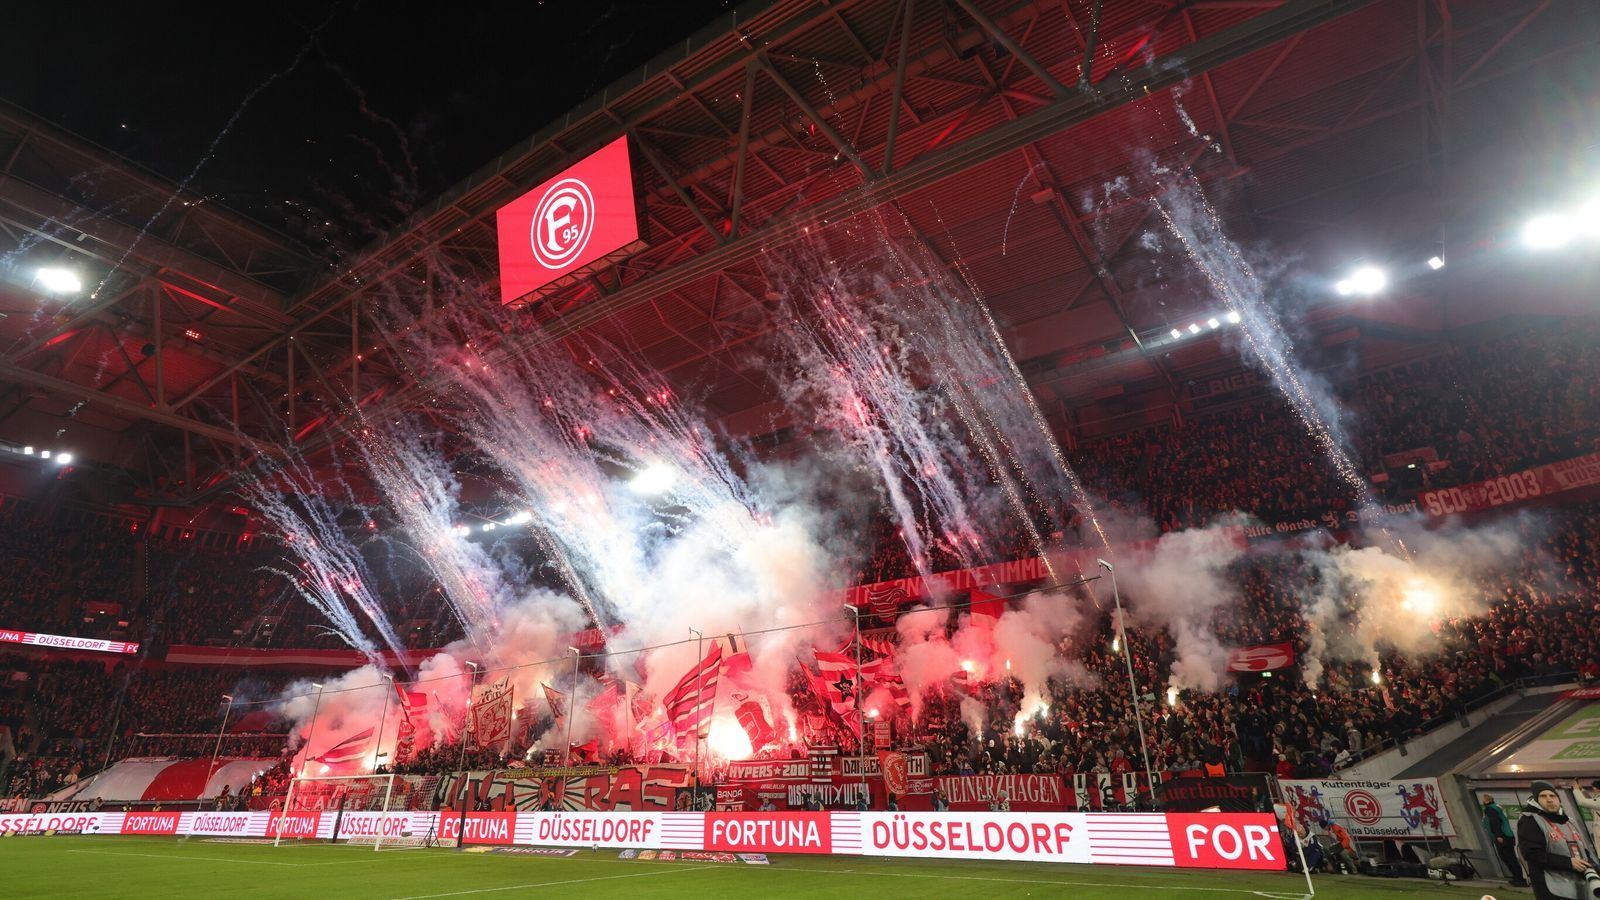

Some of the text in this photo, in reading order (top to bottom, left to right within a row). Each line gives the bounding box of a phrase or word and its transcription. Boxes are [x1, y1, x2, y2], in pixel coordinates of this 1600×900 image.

[562, 224, 579, 243] 95
[1425, 469, 1542, 517] SCD 2003
[38, 635, 106, 649] DÜSSELDORF
[728, 764, 773, 779] HYPERS
[782, 763, 810, 777] 2001
[717, 789, 743, 799] BANDA
[940, 774, 1060, 803] MEINERZHAGEN
[1321, 781, 1391, 789] Kuttenträger
[125, 816, 175, 831] FORTUNA
[193, 814, 248, 832] DÜSSELDORF
[443, 817, 509, 840] FORTUNA
[539, 814, 654, 843] DÜSSELDORF
[1364, 826, 1411, 835] Düsseldorf
[712, 819, 822, 847] FORTUNA
[872, 815, 1074, 855] DÜSSELDORF
